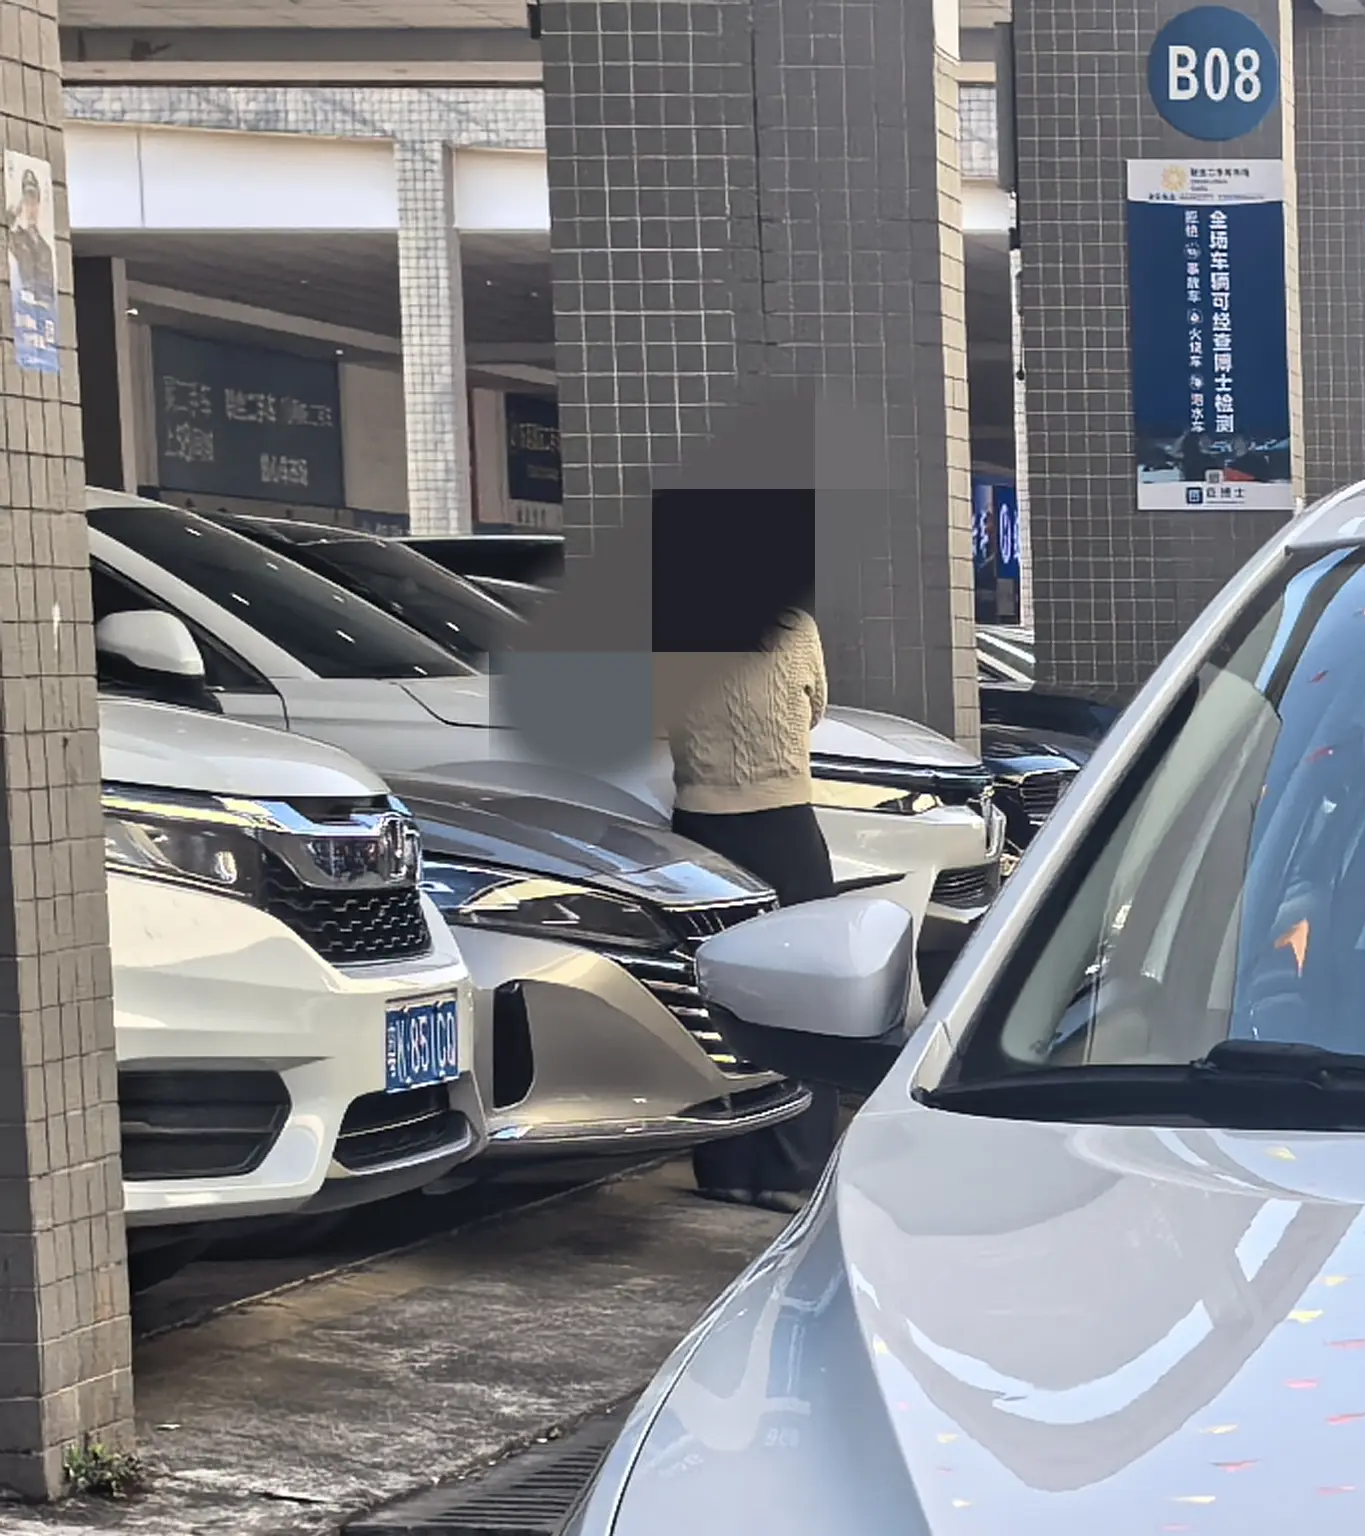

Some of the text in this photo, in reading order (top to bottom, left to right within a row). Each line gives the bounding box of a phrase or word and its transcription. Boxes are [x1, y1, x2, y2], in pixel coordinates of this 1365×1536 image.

[1166, 45, 1262, 102] B08
[1208, 209, 1235, 433] 全场车辆可经查博士检测
